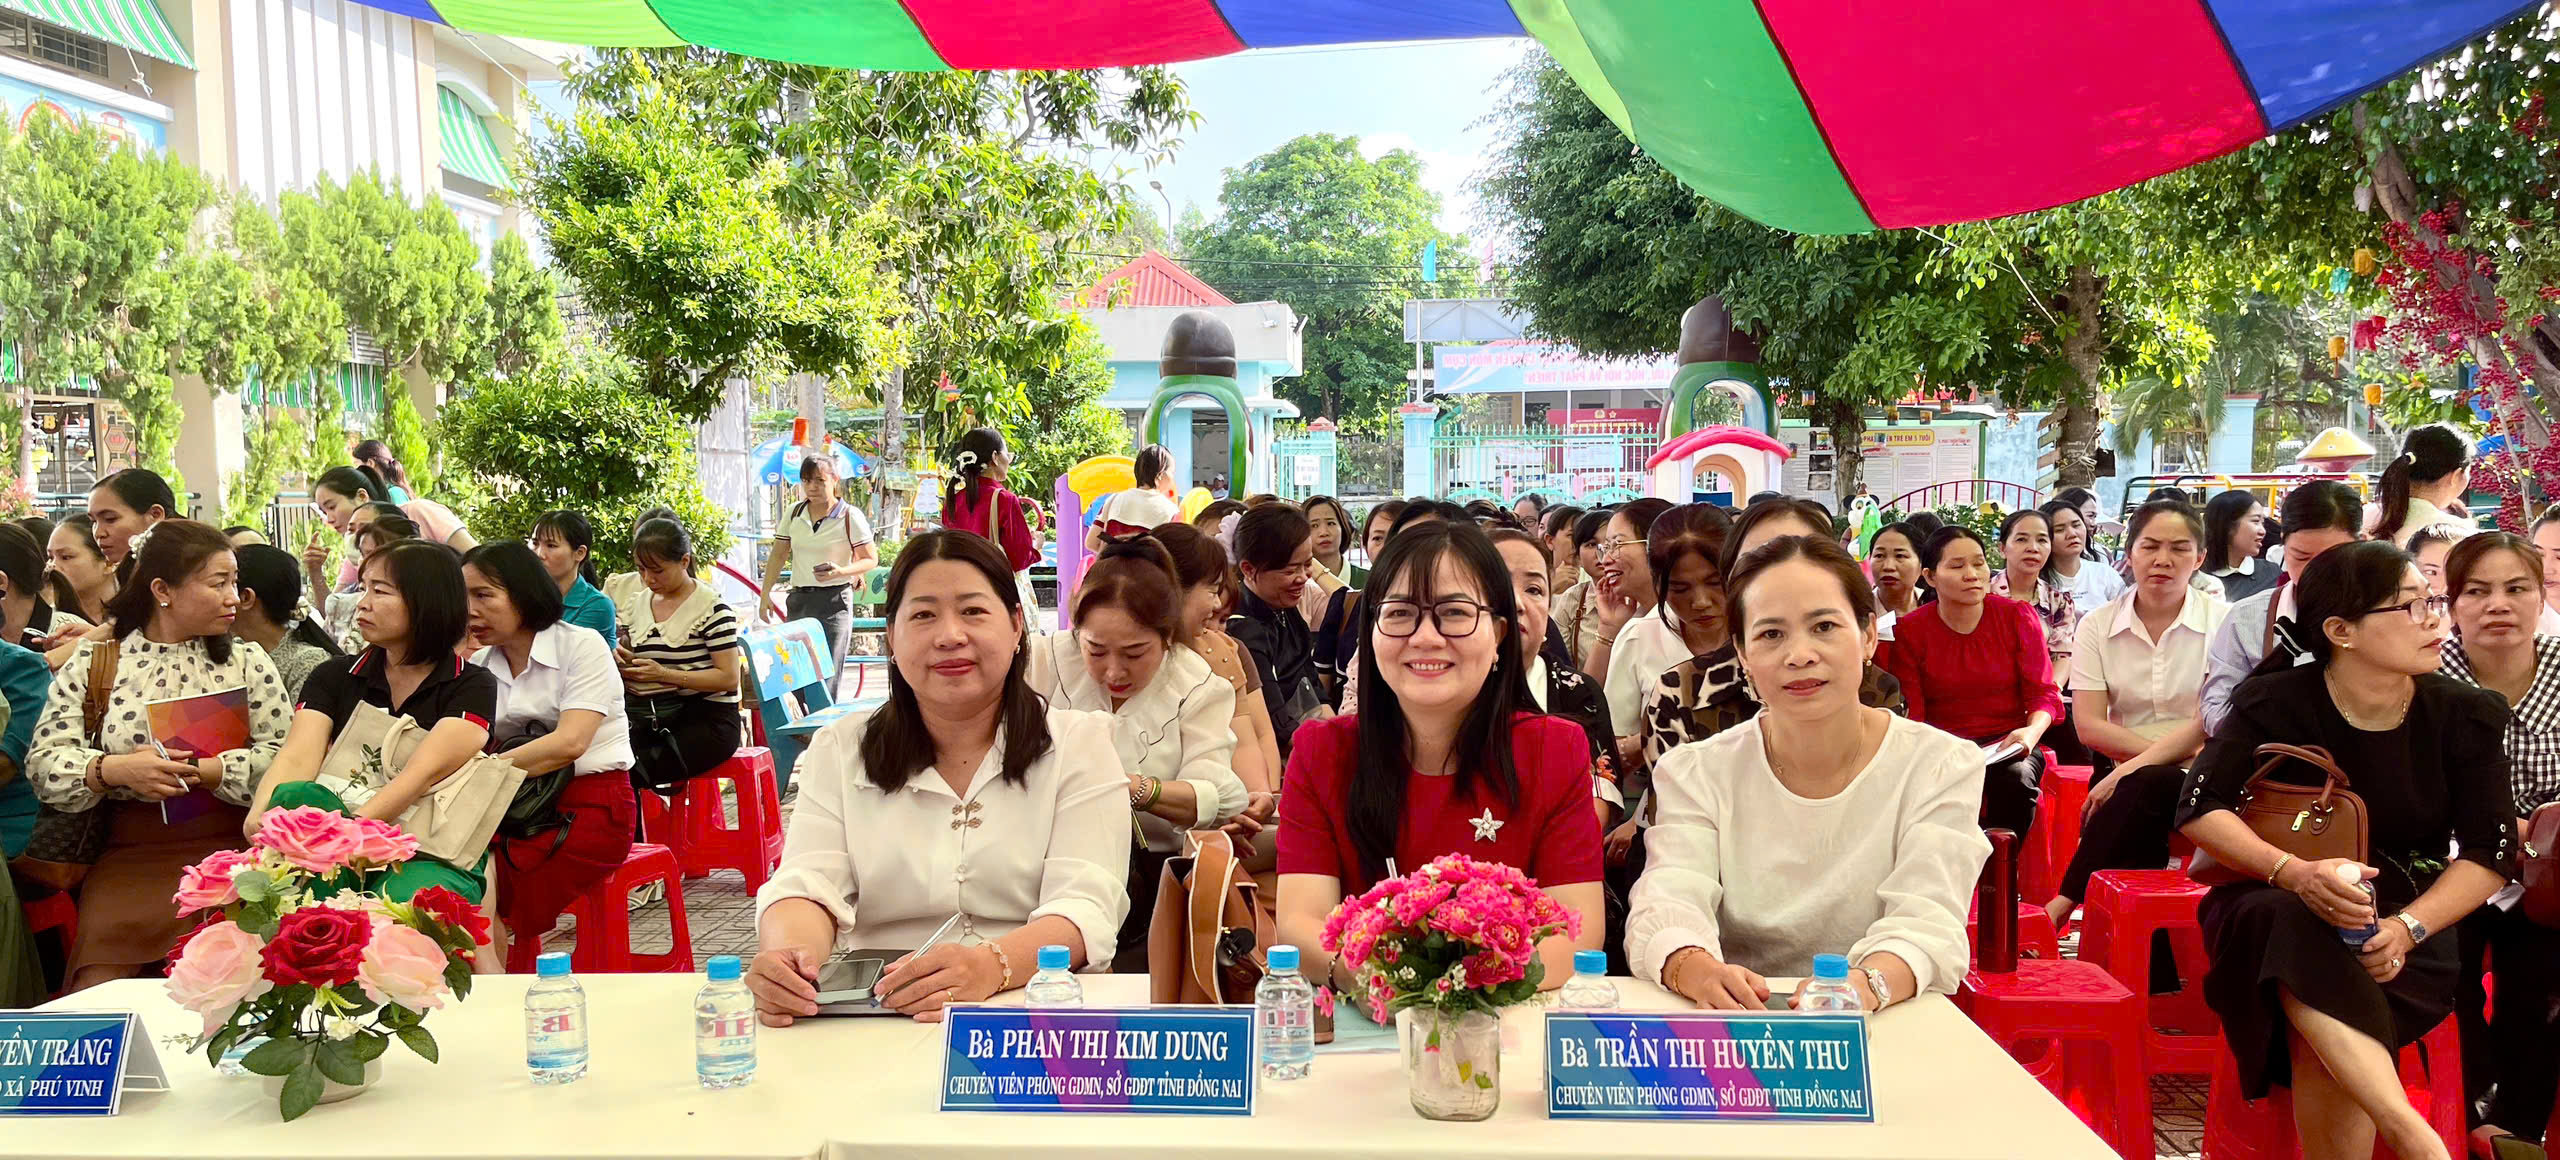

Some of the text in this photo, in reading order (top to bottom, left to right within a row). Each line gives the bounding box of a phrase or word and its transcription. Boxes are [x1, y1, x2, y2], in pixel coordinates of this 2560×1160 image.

[40, 1038, 113, 1067] TRANG
[967, 1029, 1228, 1066] Bà PHAN THỊ KIM DUNG
[1559, 1021, 1850, 1076] Bà TRẦN THỊ HUYỀN THU
[4, 1075, 26, 1097] XÃ
[28, 1075, 62, 1097] PHÚ
[66, 1079, 104, 1097] VINH
[950, 1068, 1242, 1099] CHUYÊN VIÊN PHÒNG GDMN, SỞ GDĐT TỈNH ĐỒNG NAI
[1555, 1079, 1863, 1110] CHUYÊN VIÊN PHÒNG GDMN, SỞ GDĐT TỈNH ĐỒNG NAI
